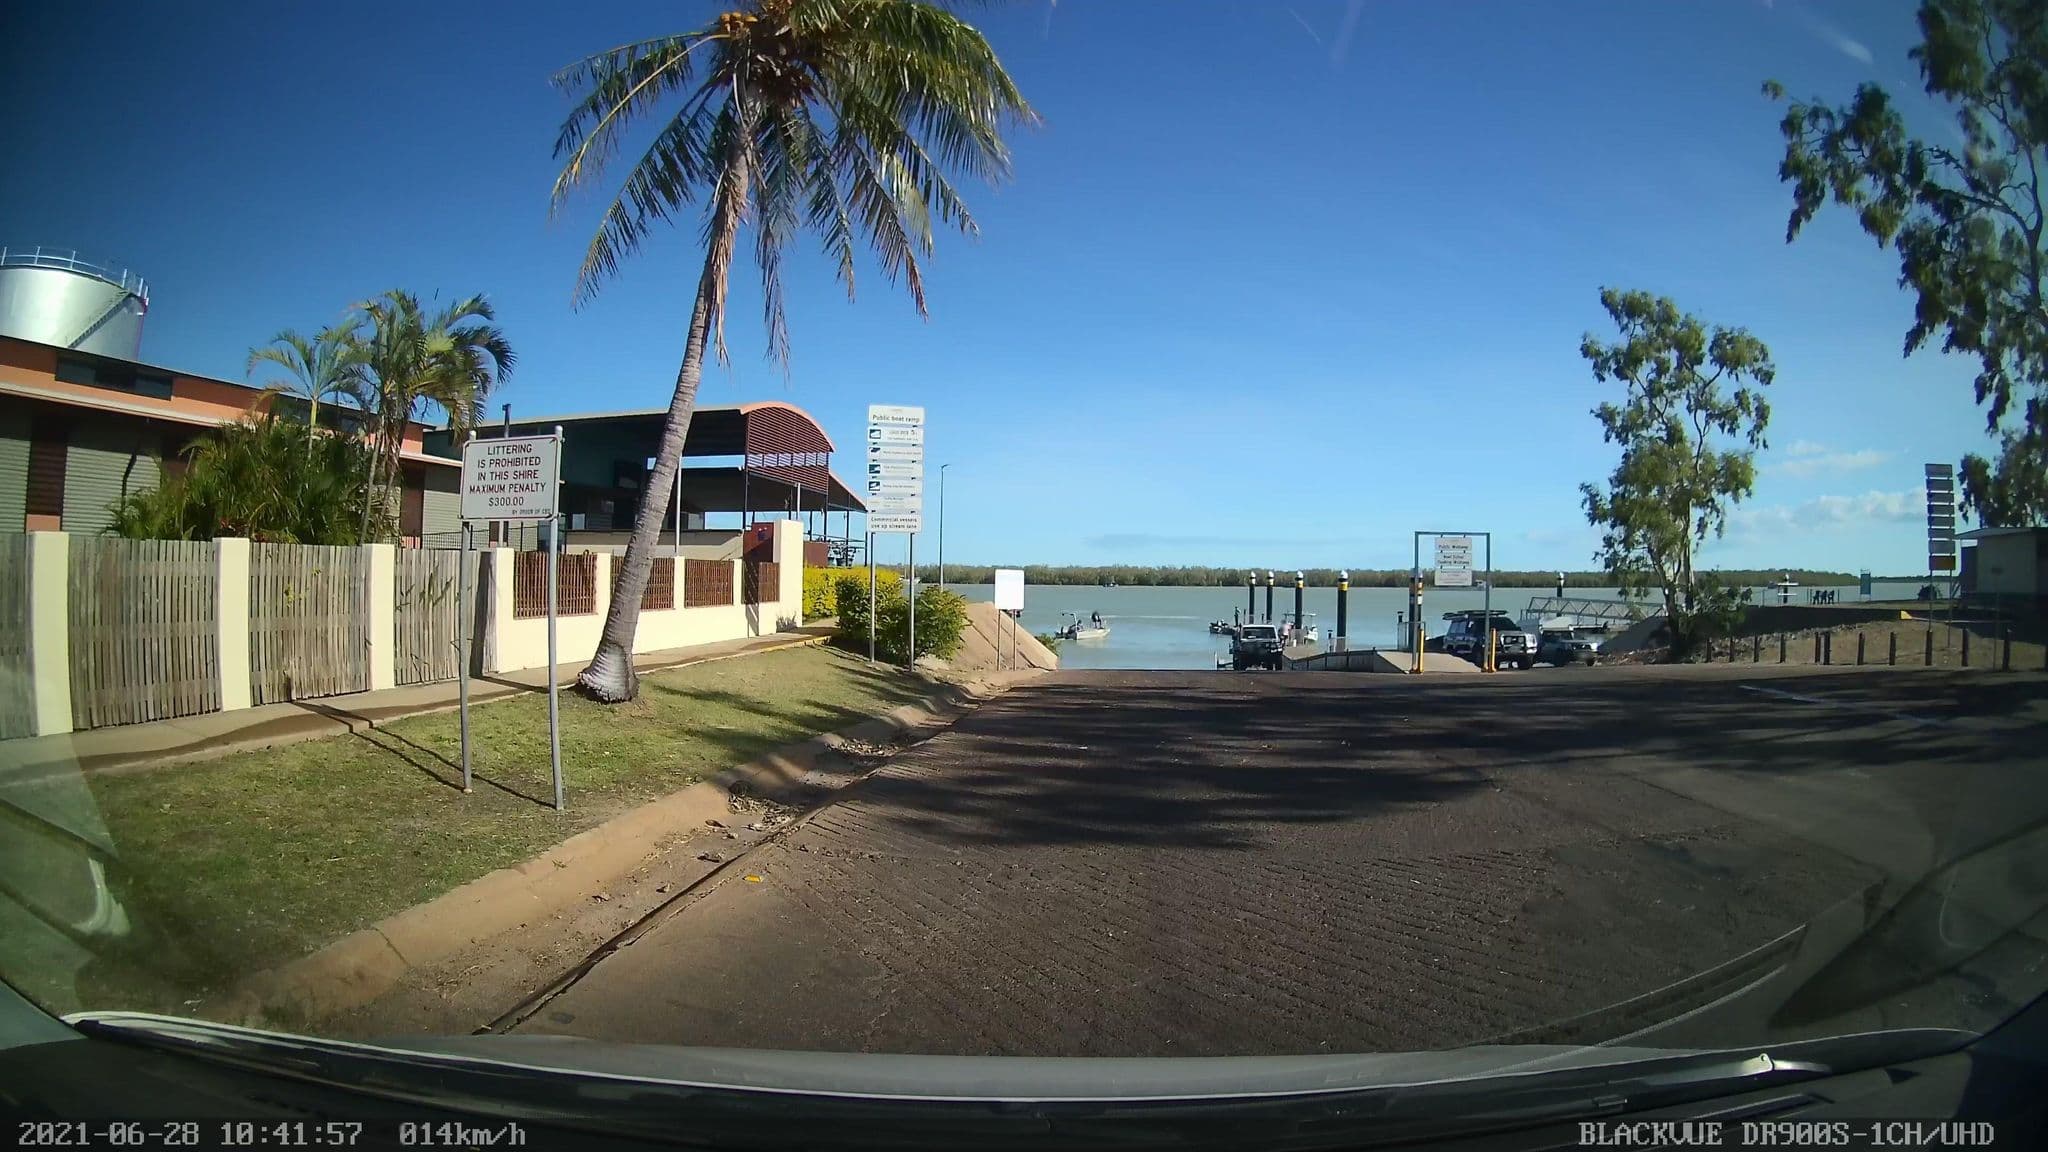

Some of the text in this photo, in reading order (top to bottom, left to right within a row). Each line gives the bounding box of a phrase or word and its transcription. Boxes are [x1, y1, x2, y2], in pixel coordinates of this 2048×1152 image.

[487, 443, 533, 456] LITTERING
[477, 456, 541, 469] IS PROHIBITED
[477, 469, 539, 481] IN THIS SHIRE
[469, 482, 546, 494] MAXIMUM PENALTY
[488, 496, 524, 507] $300.00
